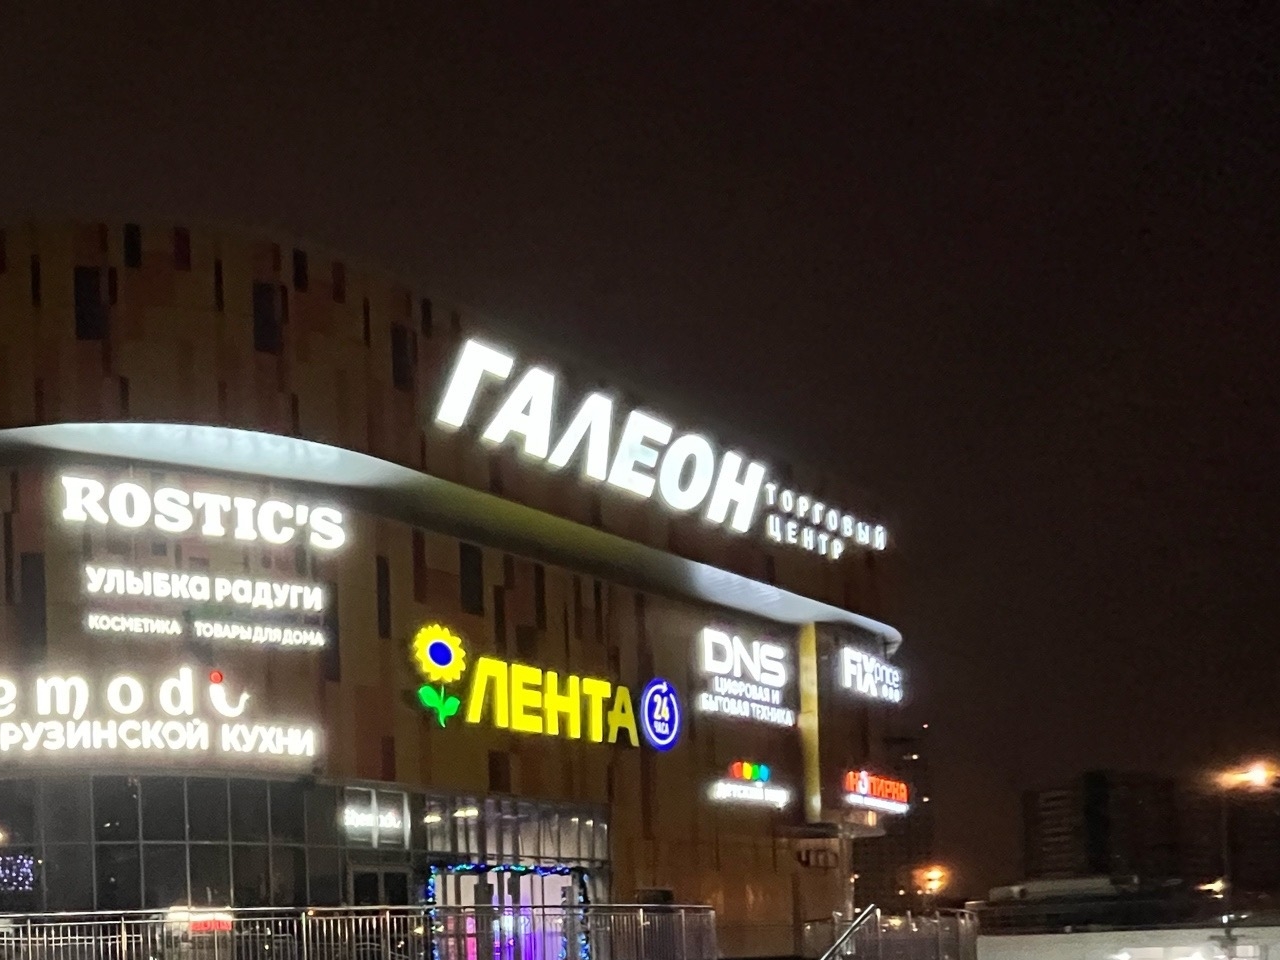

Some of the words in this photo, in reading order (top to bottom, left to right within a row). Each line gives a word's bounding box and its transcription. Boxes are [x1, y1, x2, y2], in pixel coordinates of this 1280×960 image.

[435, 338, 766, 534] ГАЛЕОН
[61, 476, 347, 549] ROSTIC'S
[765, 482, 888, 551] ТОРГОВЫЙ
[767, 513, 846, 561] ЦЕНТР
[88, 614, 183, 635] КОСМЕТИКА
[194, 621, 252, 640] ТОВАРЫ
[252, 626, 282, 643] ДЛЯ
[282, 629, 325, 647] ДОМА
[702, 627, 786, 688] DNS
[467, 656, 640, 748] ЛЕНТА
[653, 693, 670, 722] 24
[701, 692, 750, 717] БЫТОВАЯ
[750, 702, 794, 726] ТЕХНИКА
[714, 675, 770, 703] ЦИФРОВАЯ
[771, 689, 780, 705] И
[222, 723, 317, 757] КУХНИ
